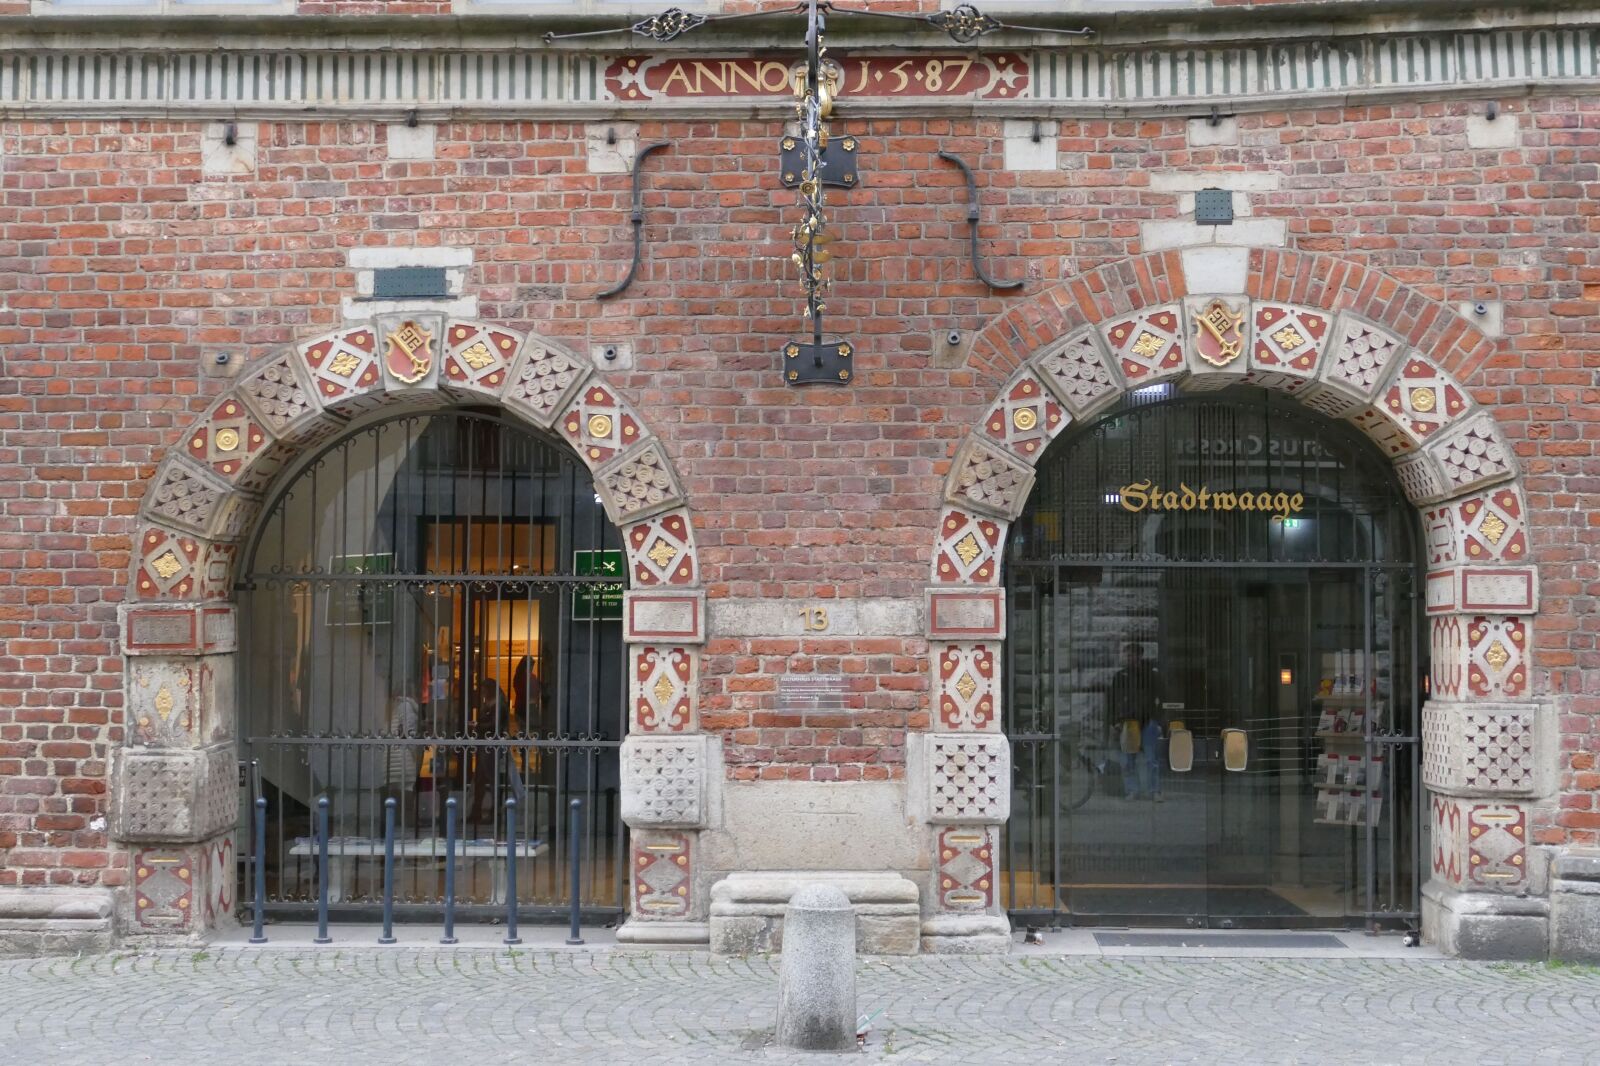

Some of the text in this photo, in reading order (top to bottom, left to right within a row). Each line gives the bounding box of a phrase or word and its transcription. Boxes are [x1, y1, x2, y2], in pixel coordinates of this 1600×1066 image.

[661, 61, 789, 93] ANNO
[1120, 479, 1303, 523] Stadtwaage
[799, 608, 829, 630] 13
